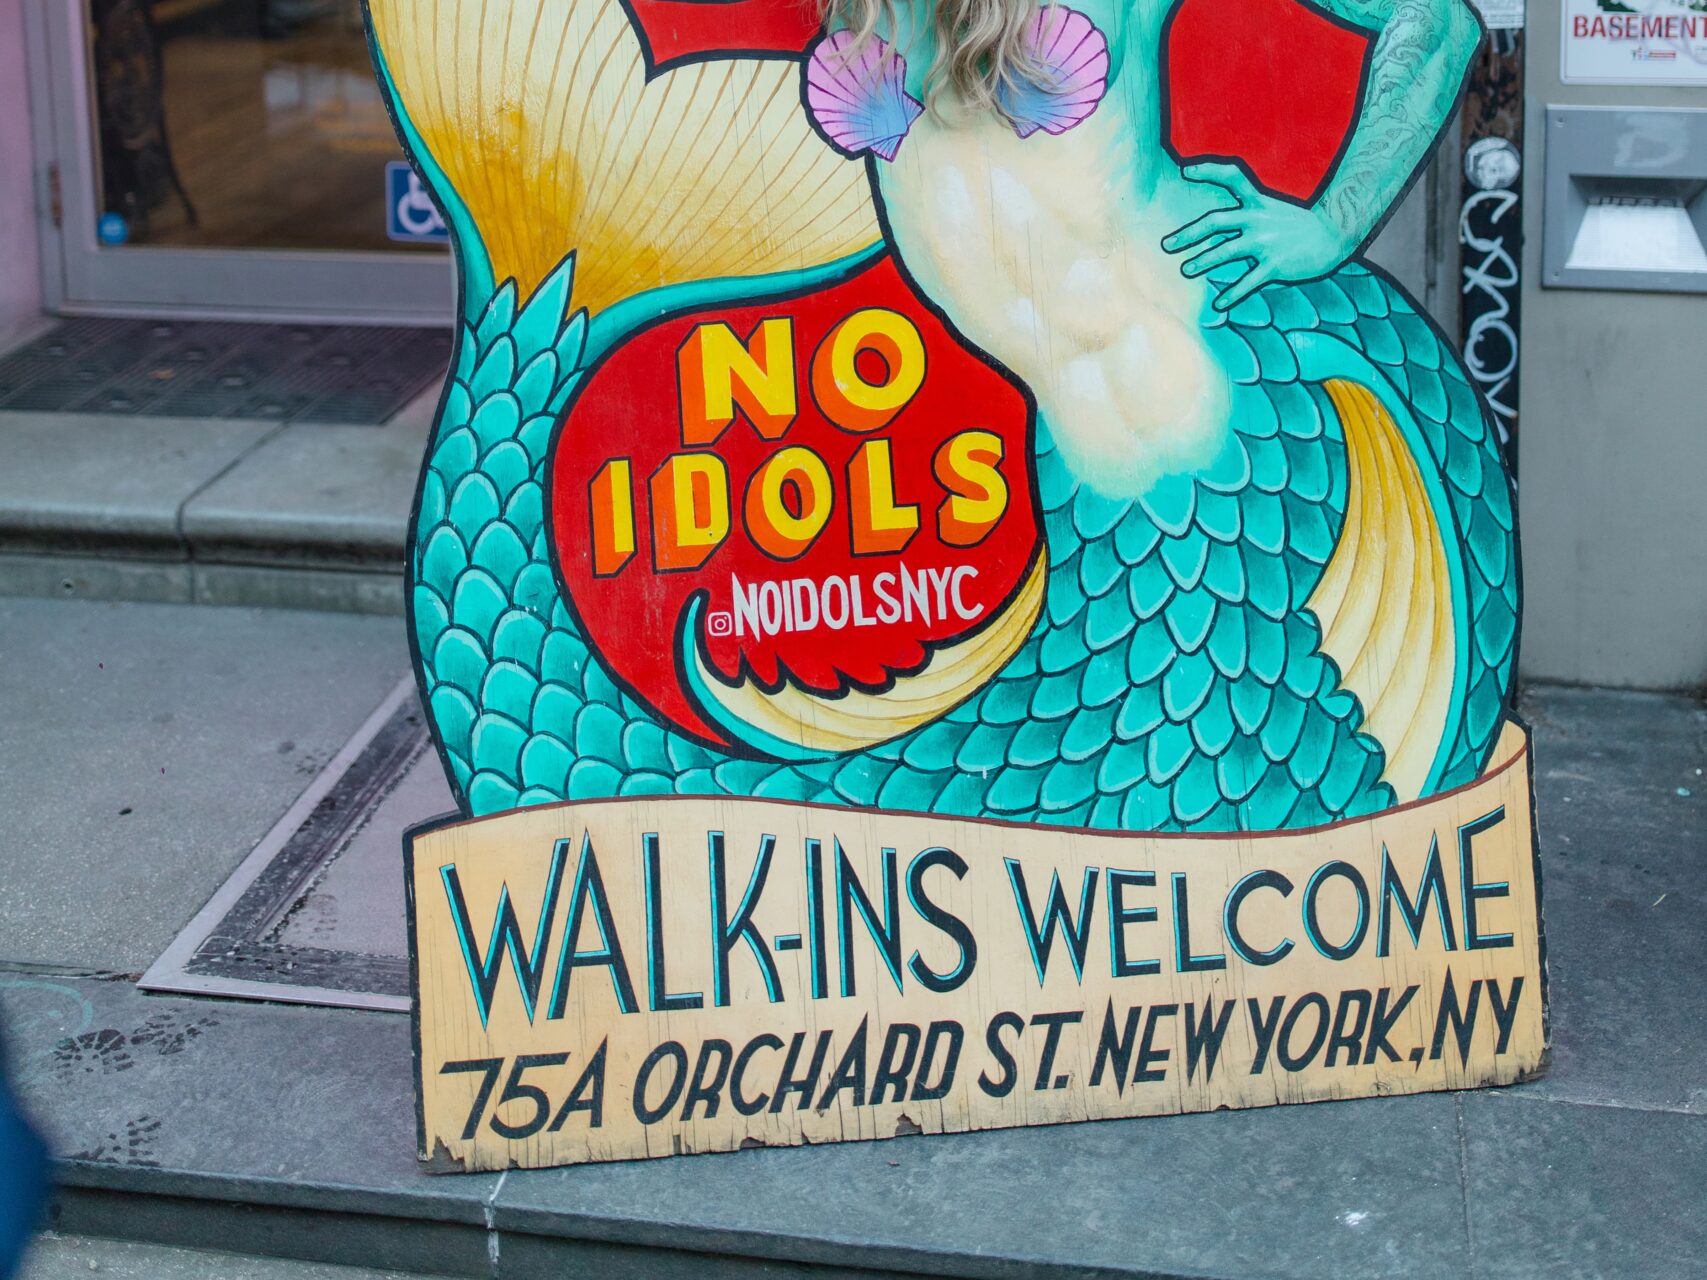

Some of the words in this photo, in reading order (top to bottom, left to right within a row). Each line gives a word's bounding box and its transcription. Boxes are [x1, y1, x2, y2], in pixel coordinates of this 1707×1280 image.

[676, 306, 928, 448] NO
[588, 428, 1010, 579] IDOLS
[732, 561, 984, 642] NOIDOLSNYC
[439, 826, 978, 1032] WALK-INS
[1003, 804, 1515, 989] WELCOME
[439, 1034, 608, 1141] 75A
[632, 1011, 965, 1126] ORCHARD
[977, 1010, 1085, 1098] ST.
[1088, 993, 1236, 1099] NEW
